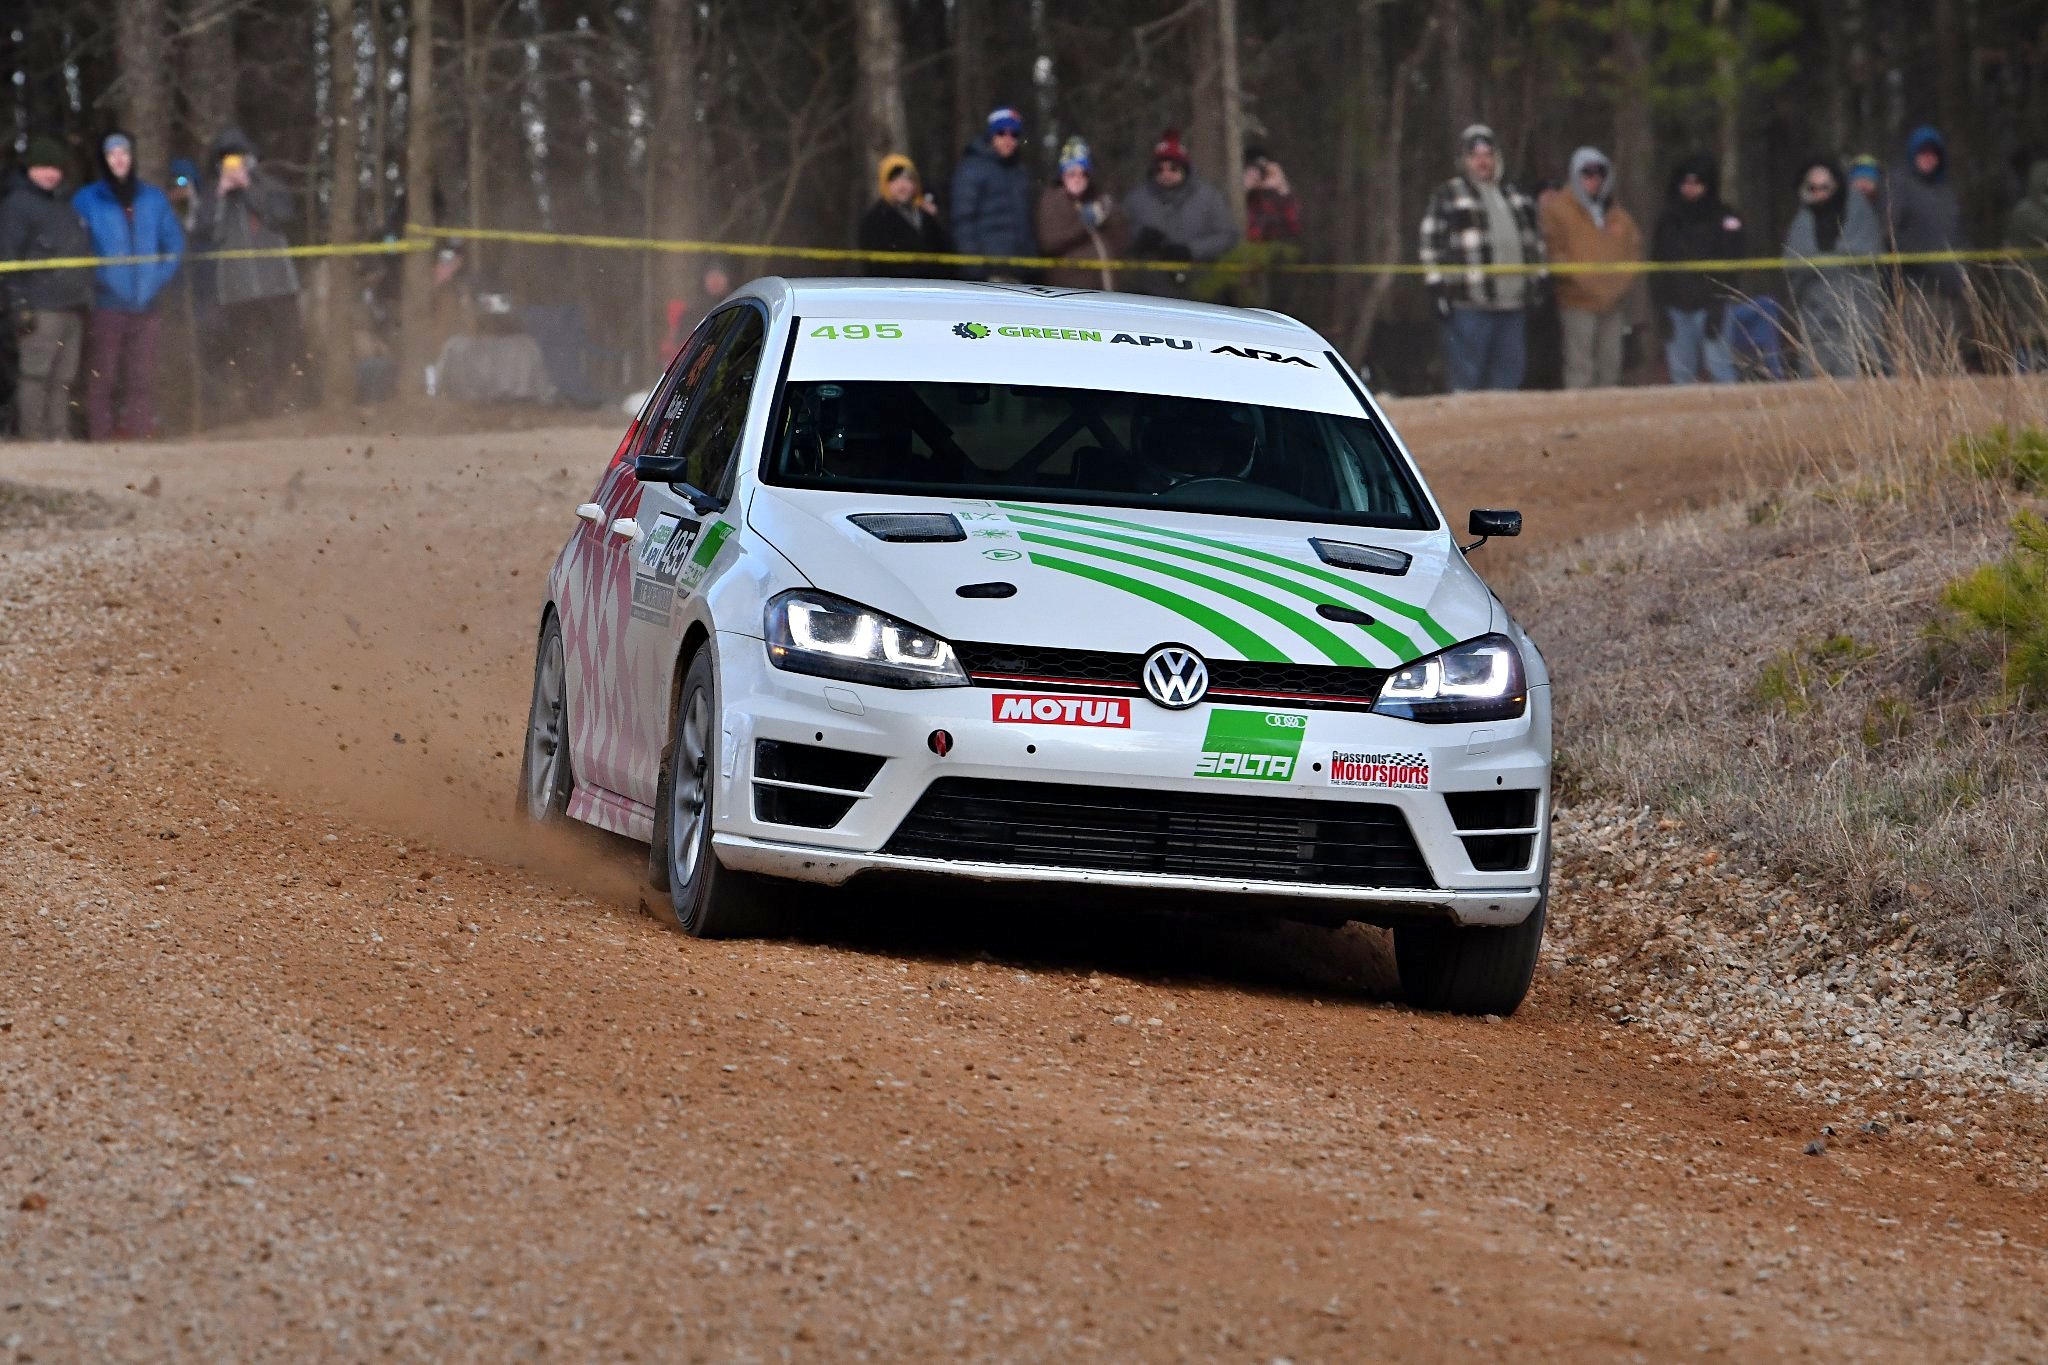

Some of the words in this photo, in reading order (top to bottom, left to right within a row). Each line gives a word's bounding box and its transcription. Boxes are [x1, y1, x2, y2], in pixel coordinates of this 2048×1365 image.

[810, 324, 903, 340] 495
[997, 326, 1102, 343] GREEN
[1110, 333, 1194, 350] APU
[1210, 345, 1320, 369] ARA
[661, 530, 697, 576] 495
[998, 698, 1125, 725] MOTUL
[1195, 751, 1293, 777] SALTA
[1332, 751, 1387, 764] Grassroots
[1331, 760, 1429, 787] Motorsports
